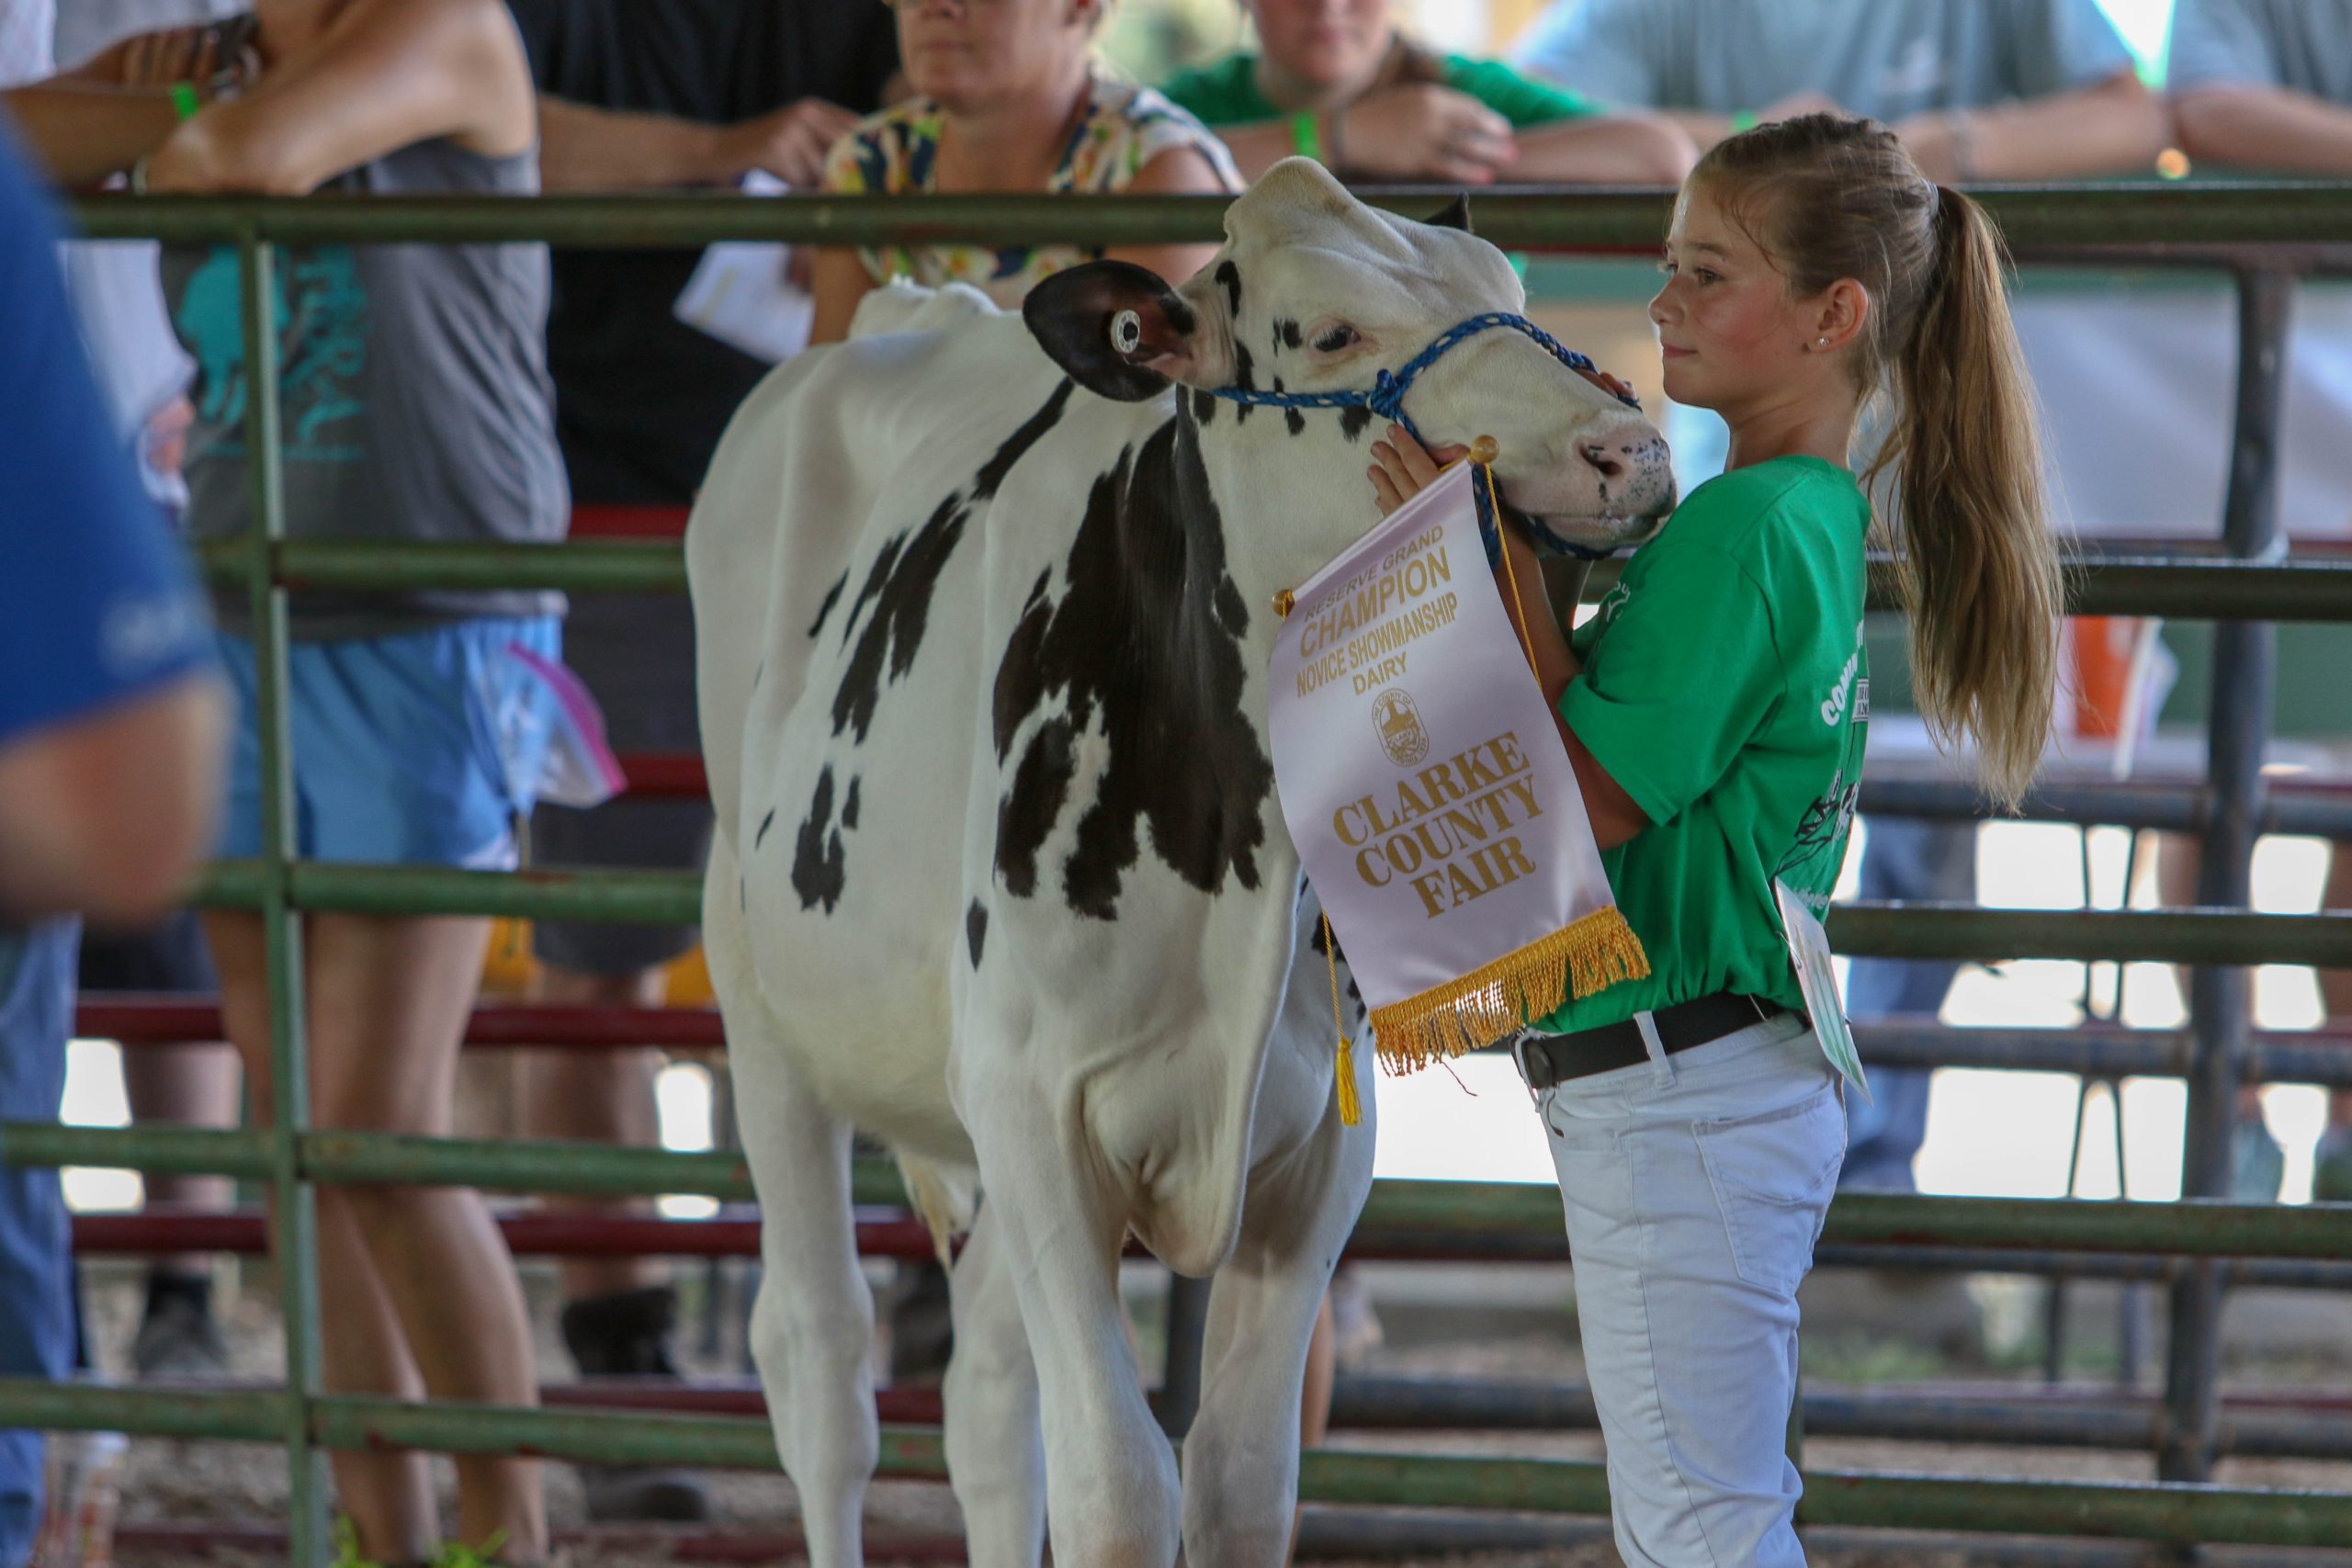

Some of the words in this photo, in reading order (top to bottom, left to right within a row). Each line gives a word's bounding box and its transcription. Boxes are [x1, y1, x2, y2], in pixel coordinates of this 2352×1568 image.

[1299, 546, 1452, 658] CHAMPION
[1304, 565, 1377, 623] RESERVE
[1383, 525, 1443, 570] GRAND
[1296, 647, 1347, 698] NOVICE
[1349, 592, 1458, 670] SHOWMANSHIP
[1352, 651, 1408, 695] DAIRY
[1333, 731, 1531, 846] CLARKE
[1356, 773, 1544, 887] COUNTY
[1409, 836, 1536, 919] FAIR
